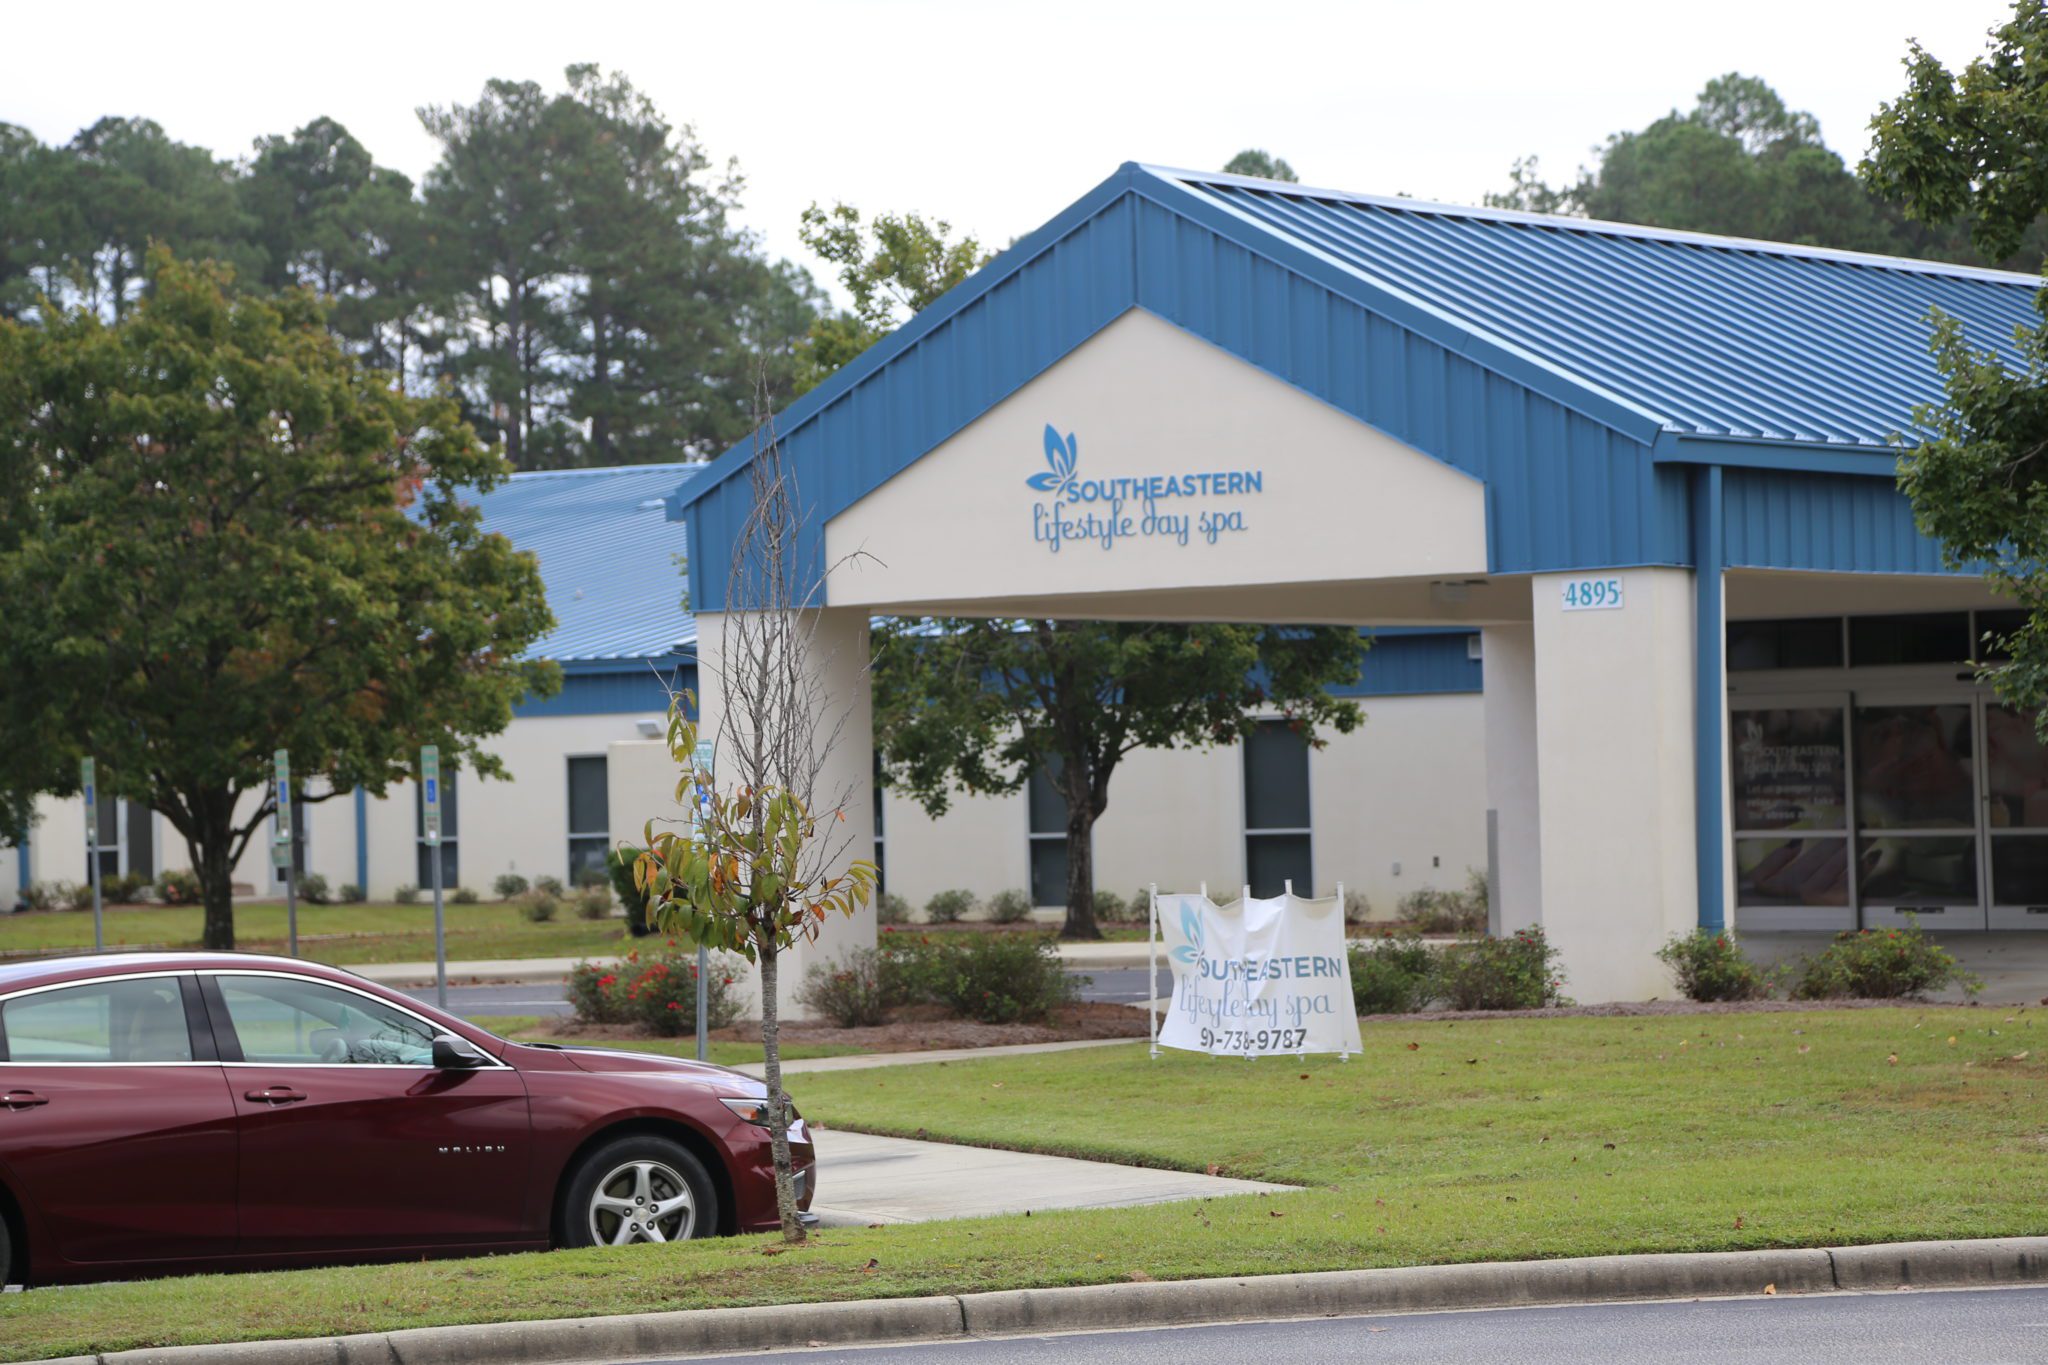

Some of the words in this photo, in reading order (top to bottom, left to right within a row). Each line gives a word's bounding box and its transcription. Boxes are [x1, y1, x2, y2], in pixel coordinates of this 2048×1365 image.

[1067, 470, 1262, 503] SOUTHEASTERN
[1033, 497, 1136, 553] lifestyle
[1141, 496, 1189, 546] day
[1198, 510, 1248, 544] spa
[1565, 580, 1619, 606] 4895
[1286, 993, 1336, 1028] spa
[438, 1145, 505, 1153] MALIBU
